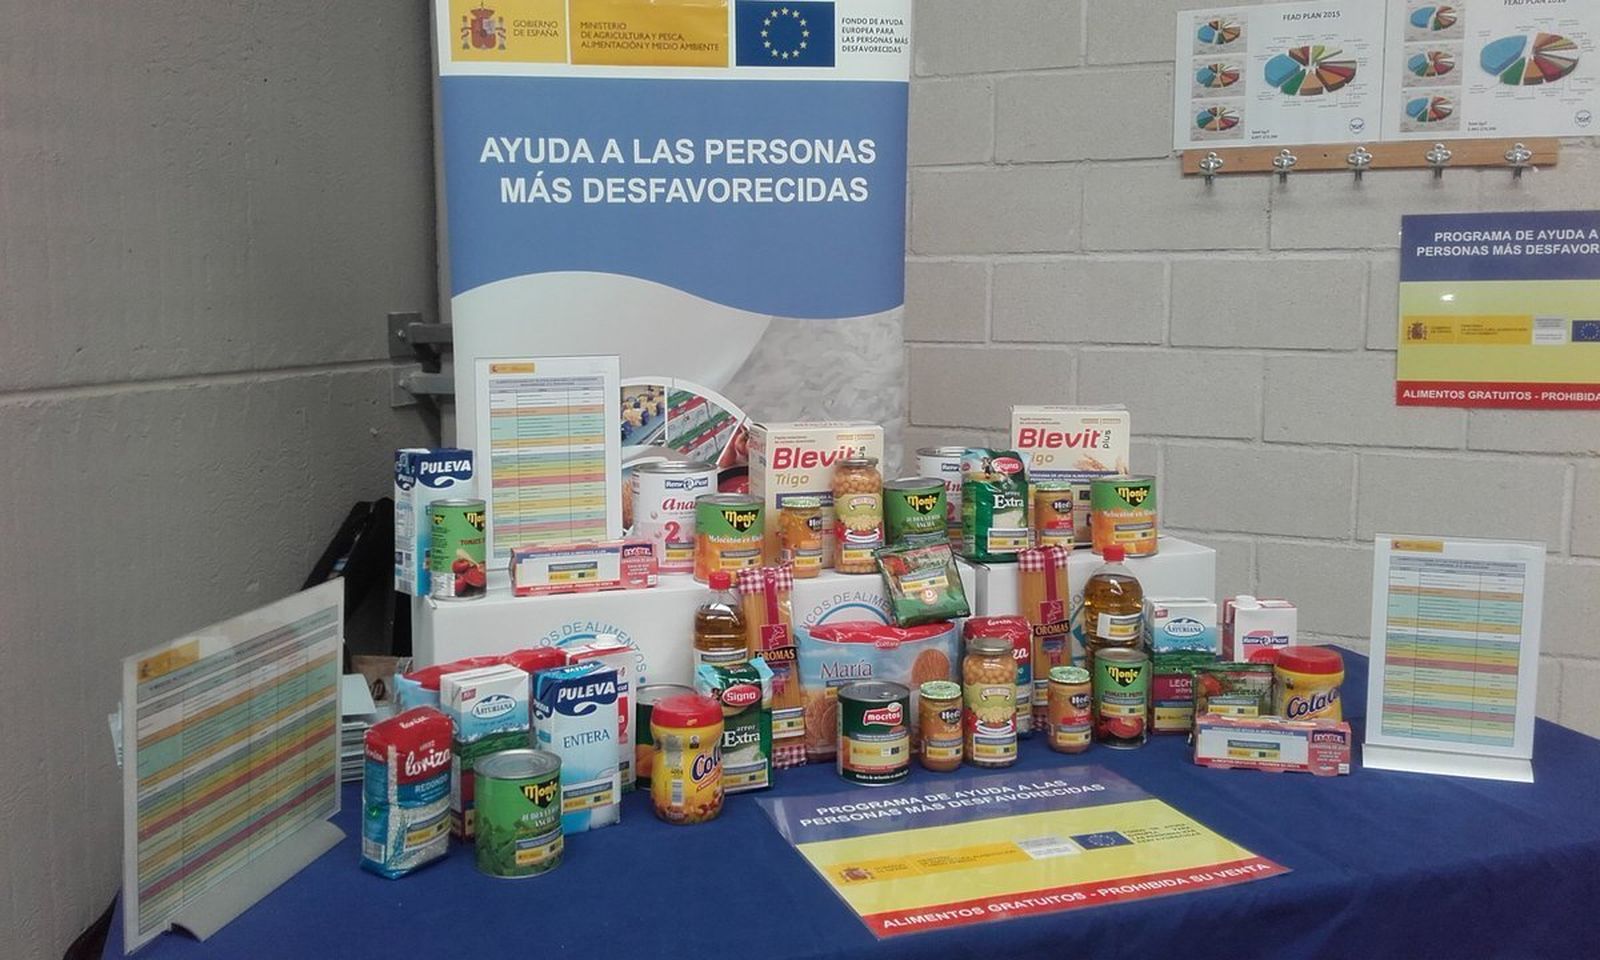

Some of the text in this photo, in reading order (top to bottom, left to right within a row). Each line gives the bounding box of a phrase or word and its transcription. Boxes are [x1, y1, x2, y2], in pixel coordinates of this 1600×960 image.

[1323, 10, 1340, 18] 2015
[513, 20, 558, 28] GOBIERNO
[580, 22, 627, 30] MINISTERIO
[876, 27, 894, 35] PARA
[514, 28, 559, 37] DE ESPAÑA
[593, 33, 650, 41] AGRICULTURA
[857, 36, 893, 44] PERSONAS
[581, 40, 645, 49] ALIMENTACIÓN
[680, 43, 719, 51] AMBIENTE
[842, 45, 902, 53] DESFAVORECIDAS
[480, 138, 876, 164] AYUDA A LAS PERSONAS
[501, 171, 868, 203] MÁS DESFAVORECIDAS
[1434, 230, 1598, 242] PROGRAMA DE AYUDA A
[1416, 243, 1600, 257] PERSONAS MÁS DESFAVOR
[1403, 389, 1465, 400] ALIMENTOS
[1468, 390, 1532, 401] GRATUITOS
[1541, 391, 1600, 402] PROHIBIDA
[1018, 428, 1101, 449] Blevit
[773, 445, 856, 470] Blevit
[420, 459, 472, 475] PULEVA
[775, 473, 809, 488] Trigo
[993, 494, 1024, 509] Extra
[725, 511, 757, 528] Monje
[665, 521, 680, 543] 2
[833, 592, 851, 604] DE
[562, 621, 582, 636] DE
[821, 659, 873, 679] María
[1108, 667, 1138, 683] Monje
[557, 681, 616, 703] PULEVA
[727, 692, 756, 702] Signa
[563, 730, 610, 749] ENTERA
[722, 731, 761, 748] Extra
[525, 780, 557, 805] Monje
[816, 796, 922, 815] PROGRAMA
[925, 792, 951, 802] DE
[951, 786, 1016, 799] AYUDA
[1032, 780, 1068, 790] LAS
[800, 809, 902, 827] PERSONAS
[947, 784, 1105, 808] DESFAVORECIDAS
[883, 906, 985, 928] ALIMENTOS
[987, 892, 1087, 913] GRATUITOS
[1097, 877, 1191, 897] PROHIBIDA
[1189, 873, 1214, 883] SU
[1215, 863, 1272, 879] VENTA
